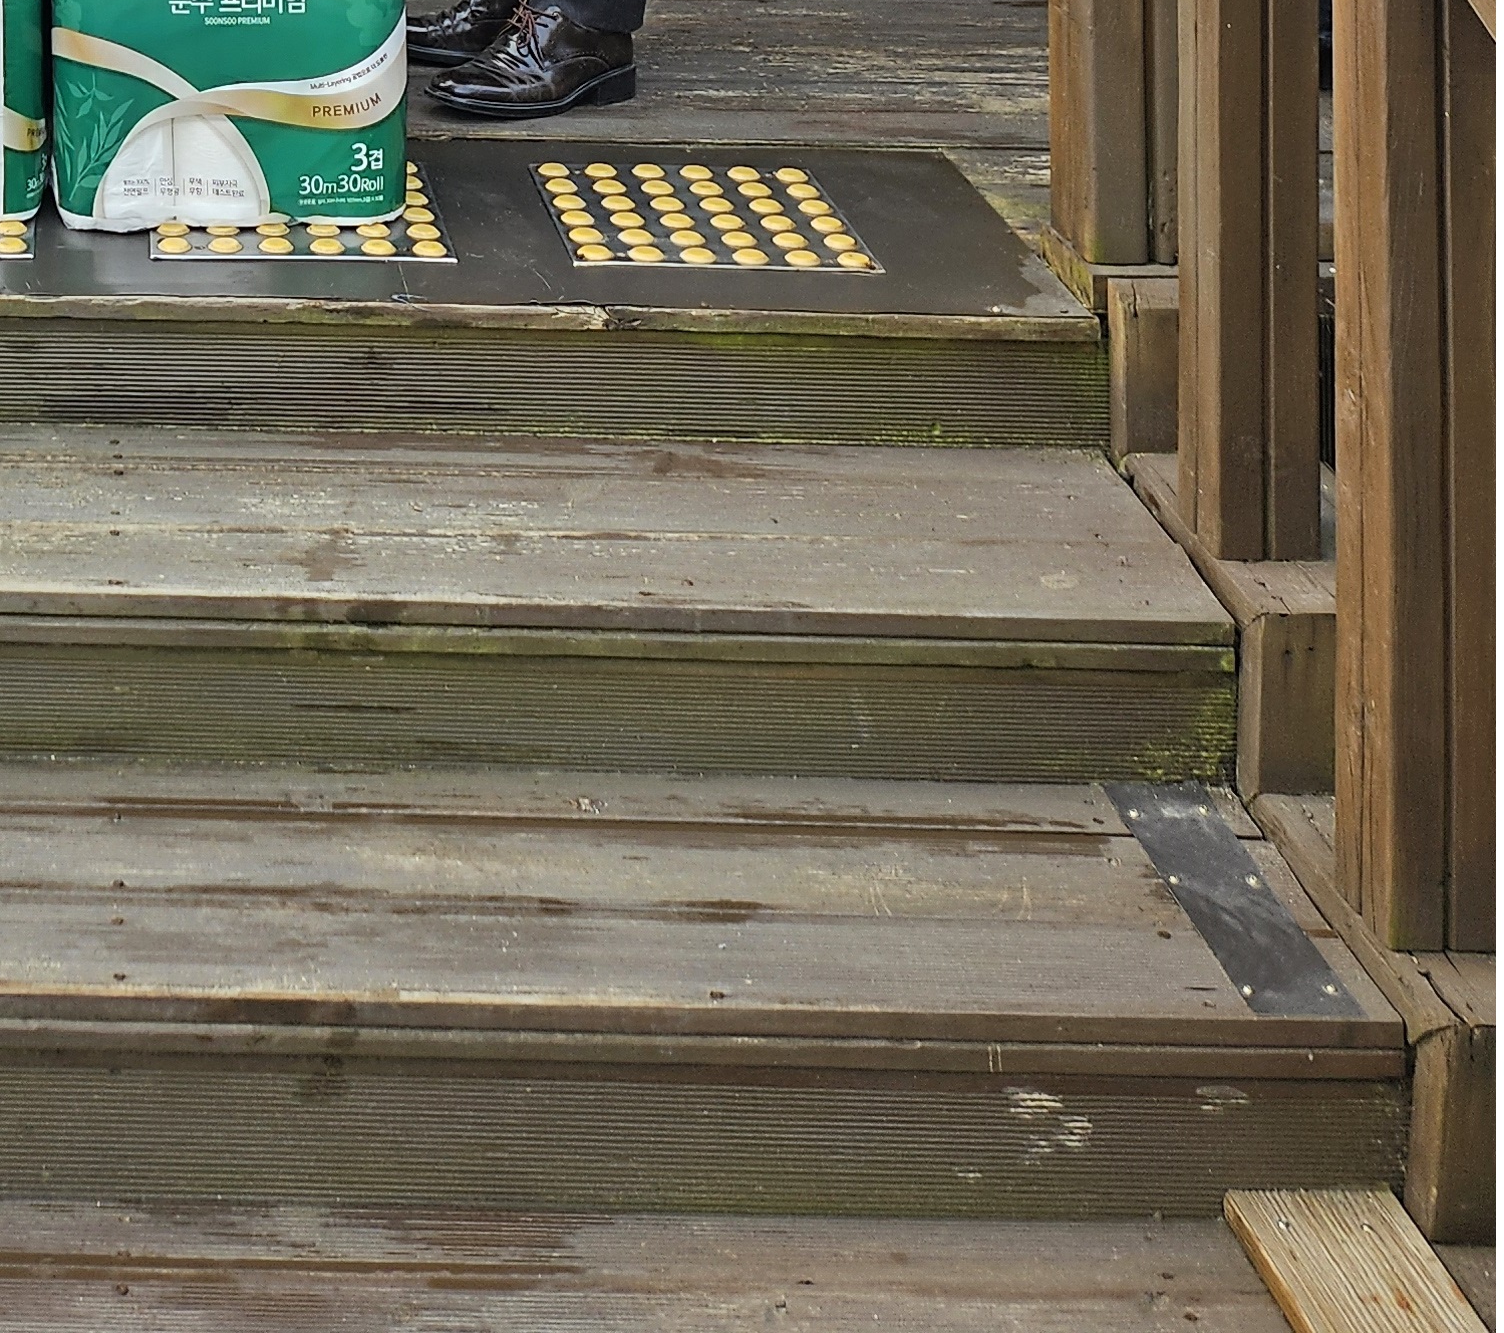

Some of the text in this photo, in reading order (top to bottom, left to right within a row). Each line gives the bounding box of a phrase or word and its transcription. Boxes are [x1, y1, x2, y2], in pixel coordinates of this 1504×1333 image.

[204, 16, 271, 25] SOONSOO PREMIUM
[312, 93, 381, 117] PREMIUM
[351, 143, 384, 172] 3겹
